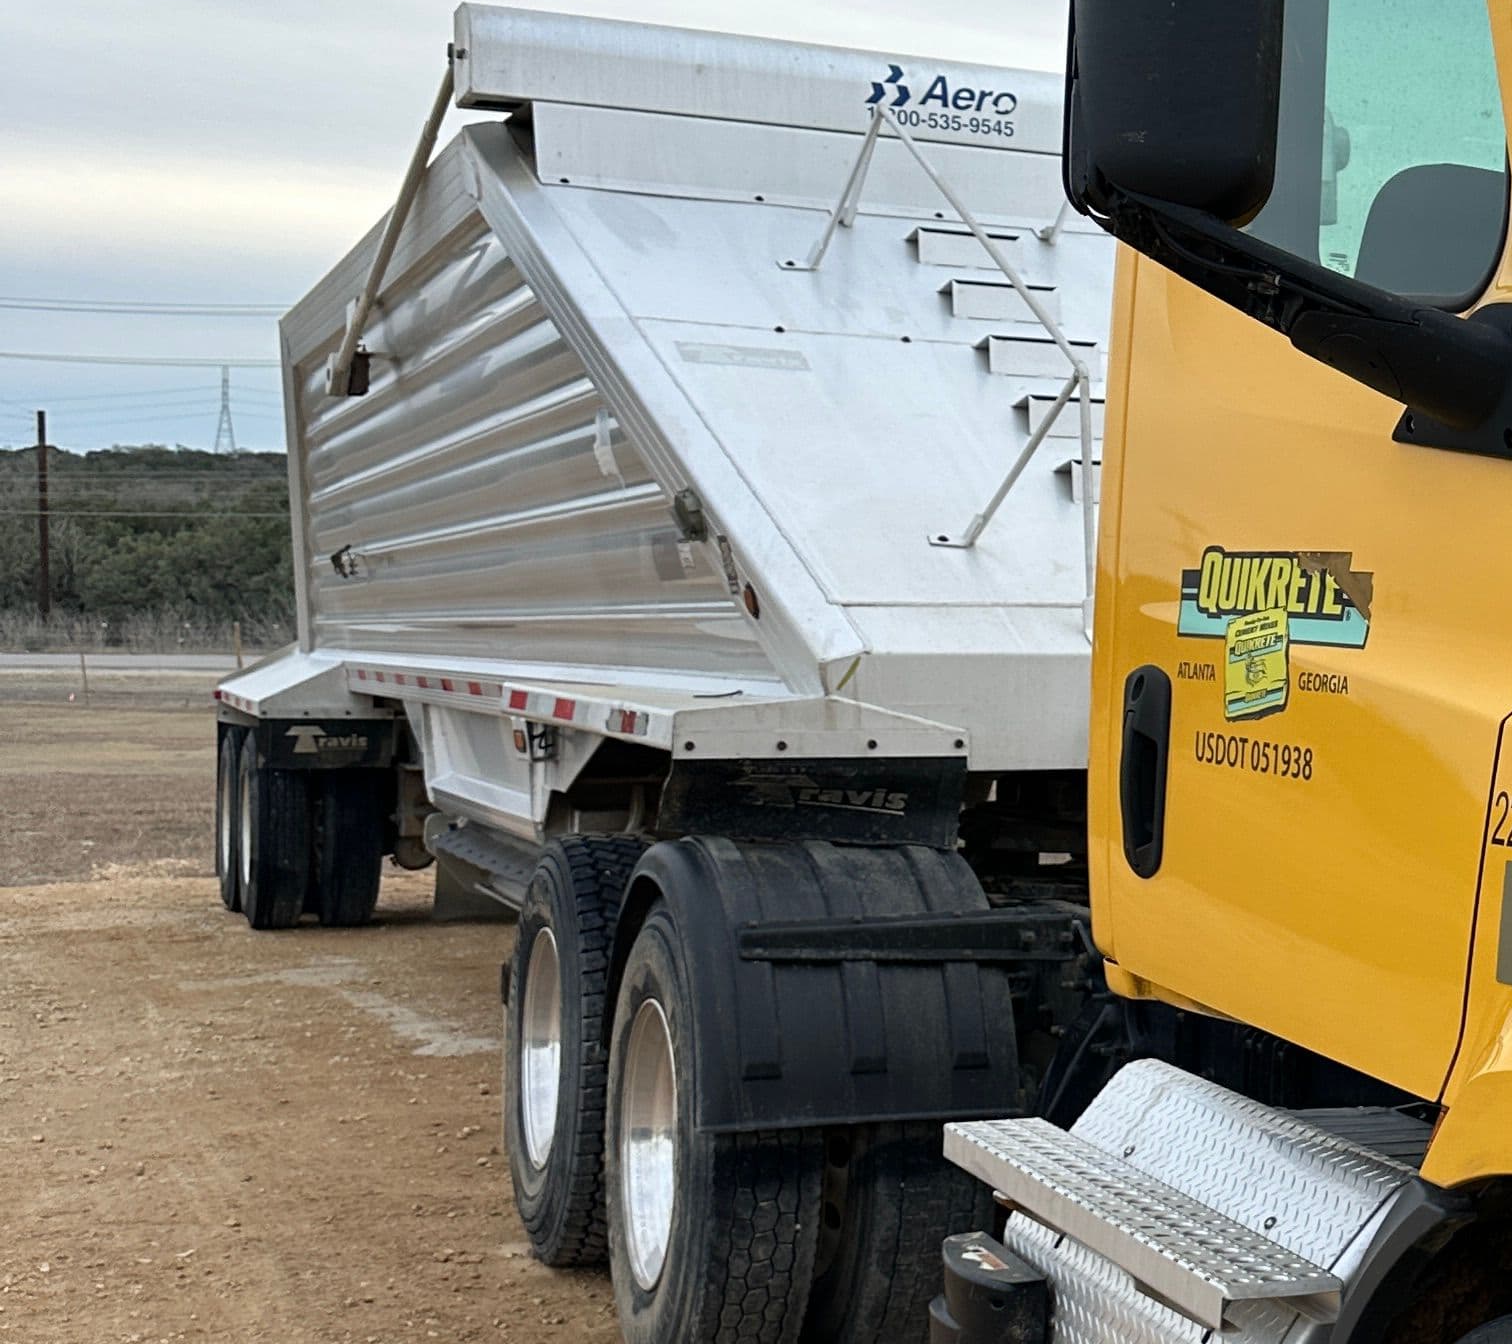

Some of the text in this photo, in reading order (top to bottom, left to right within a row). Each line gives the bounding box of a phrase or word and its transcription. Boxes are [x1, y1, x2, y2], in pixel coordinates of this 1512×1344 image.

[918, 75, 1018, 115] Aero
[867, 106, 1014, 137] 100-535-9545
[1177, 661, 1348, 695] ATLANTA GEORGIA
[285, 725, 368, 753] Travis
[1195, 731, 1313, 781] USDOT 051938
